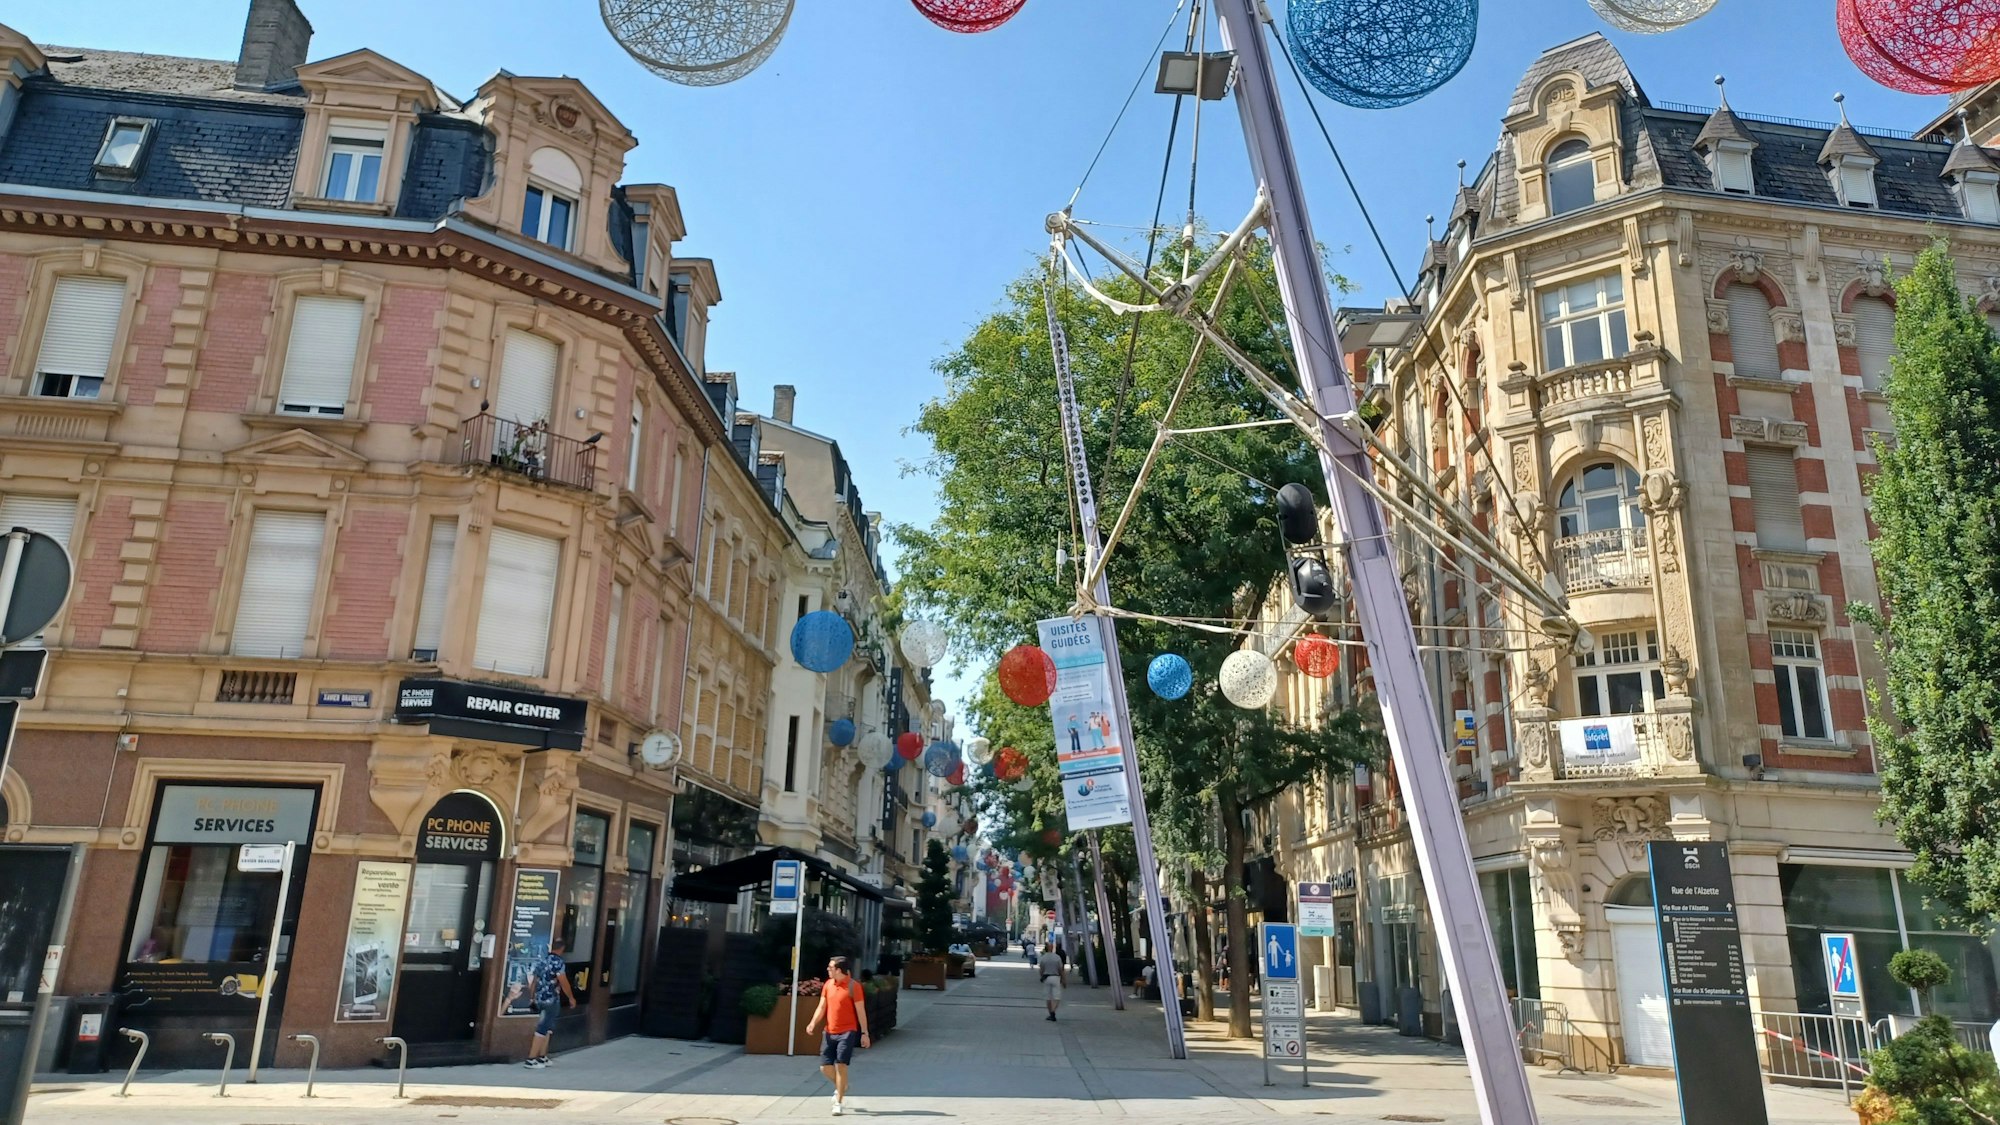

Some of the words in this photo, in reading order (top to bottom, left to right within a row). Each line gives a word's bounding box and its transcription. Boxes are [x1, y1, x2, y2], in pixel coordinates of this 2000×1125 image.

[1051, 634, 1091, 649] GUIDÉES
[401, 689, 411, 697] PC
[411, 688, 434, 697] PHONE
[401, 698, 433, 707] SERVICES
[466, 695, 511, 714] REPAIR
[514, 704, 561, 721] CENTER
[196, 798, 215, 812] PC
[223, 798, 278, 813] PHONE
[193, 818, 275, 833] SERVICES
[427, 817, 444, 832] PC
[446, 818, 491, 834] PHONE
[425, 835, 488, 851] SERVICES
[377, 881, 400, 889] vente
[1671, 886, 1684, 895] Rue
[1684, 886, 1693, 895] de
[1694, 886, 1720, 896] l'Alzette
